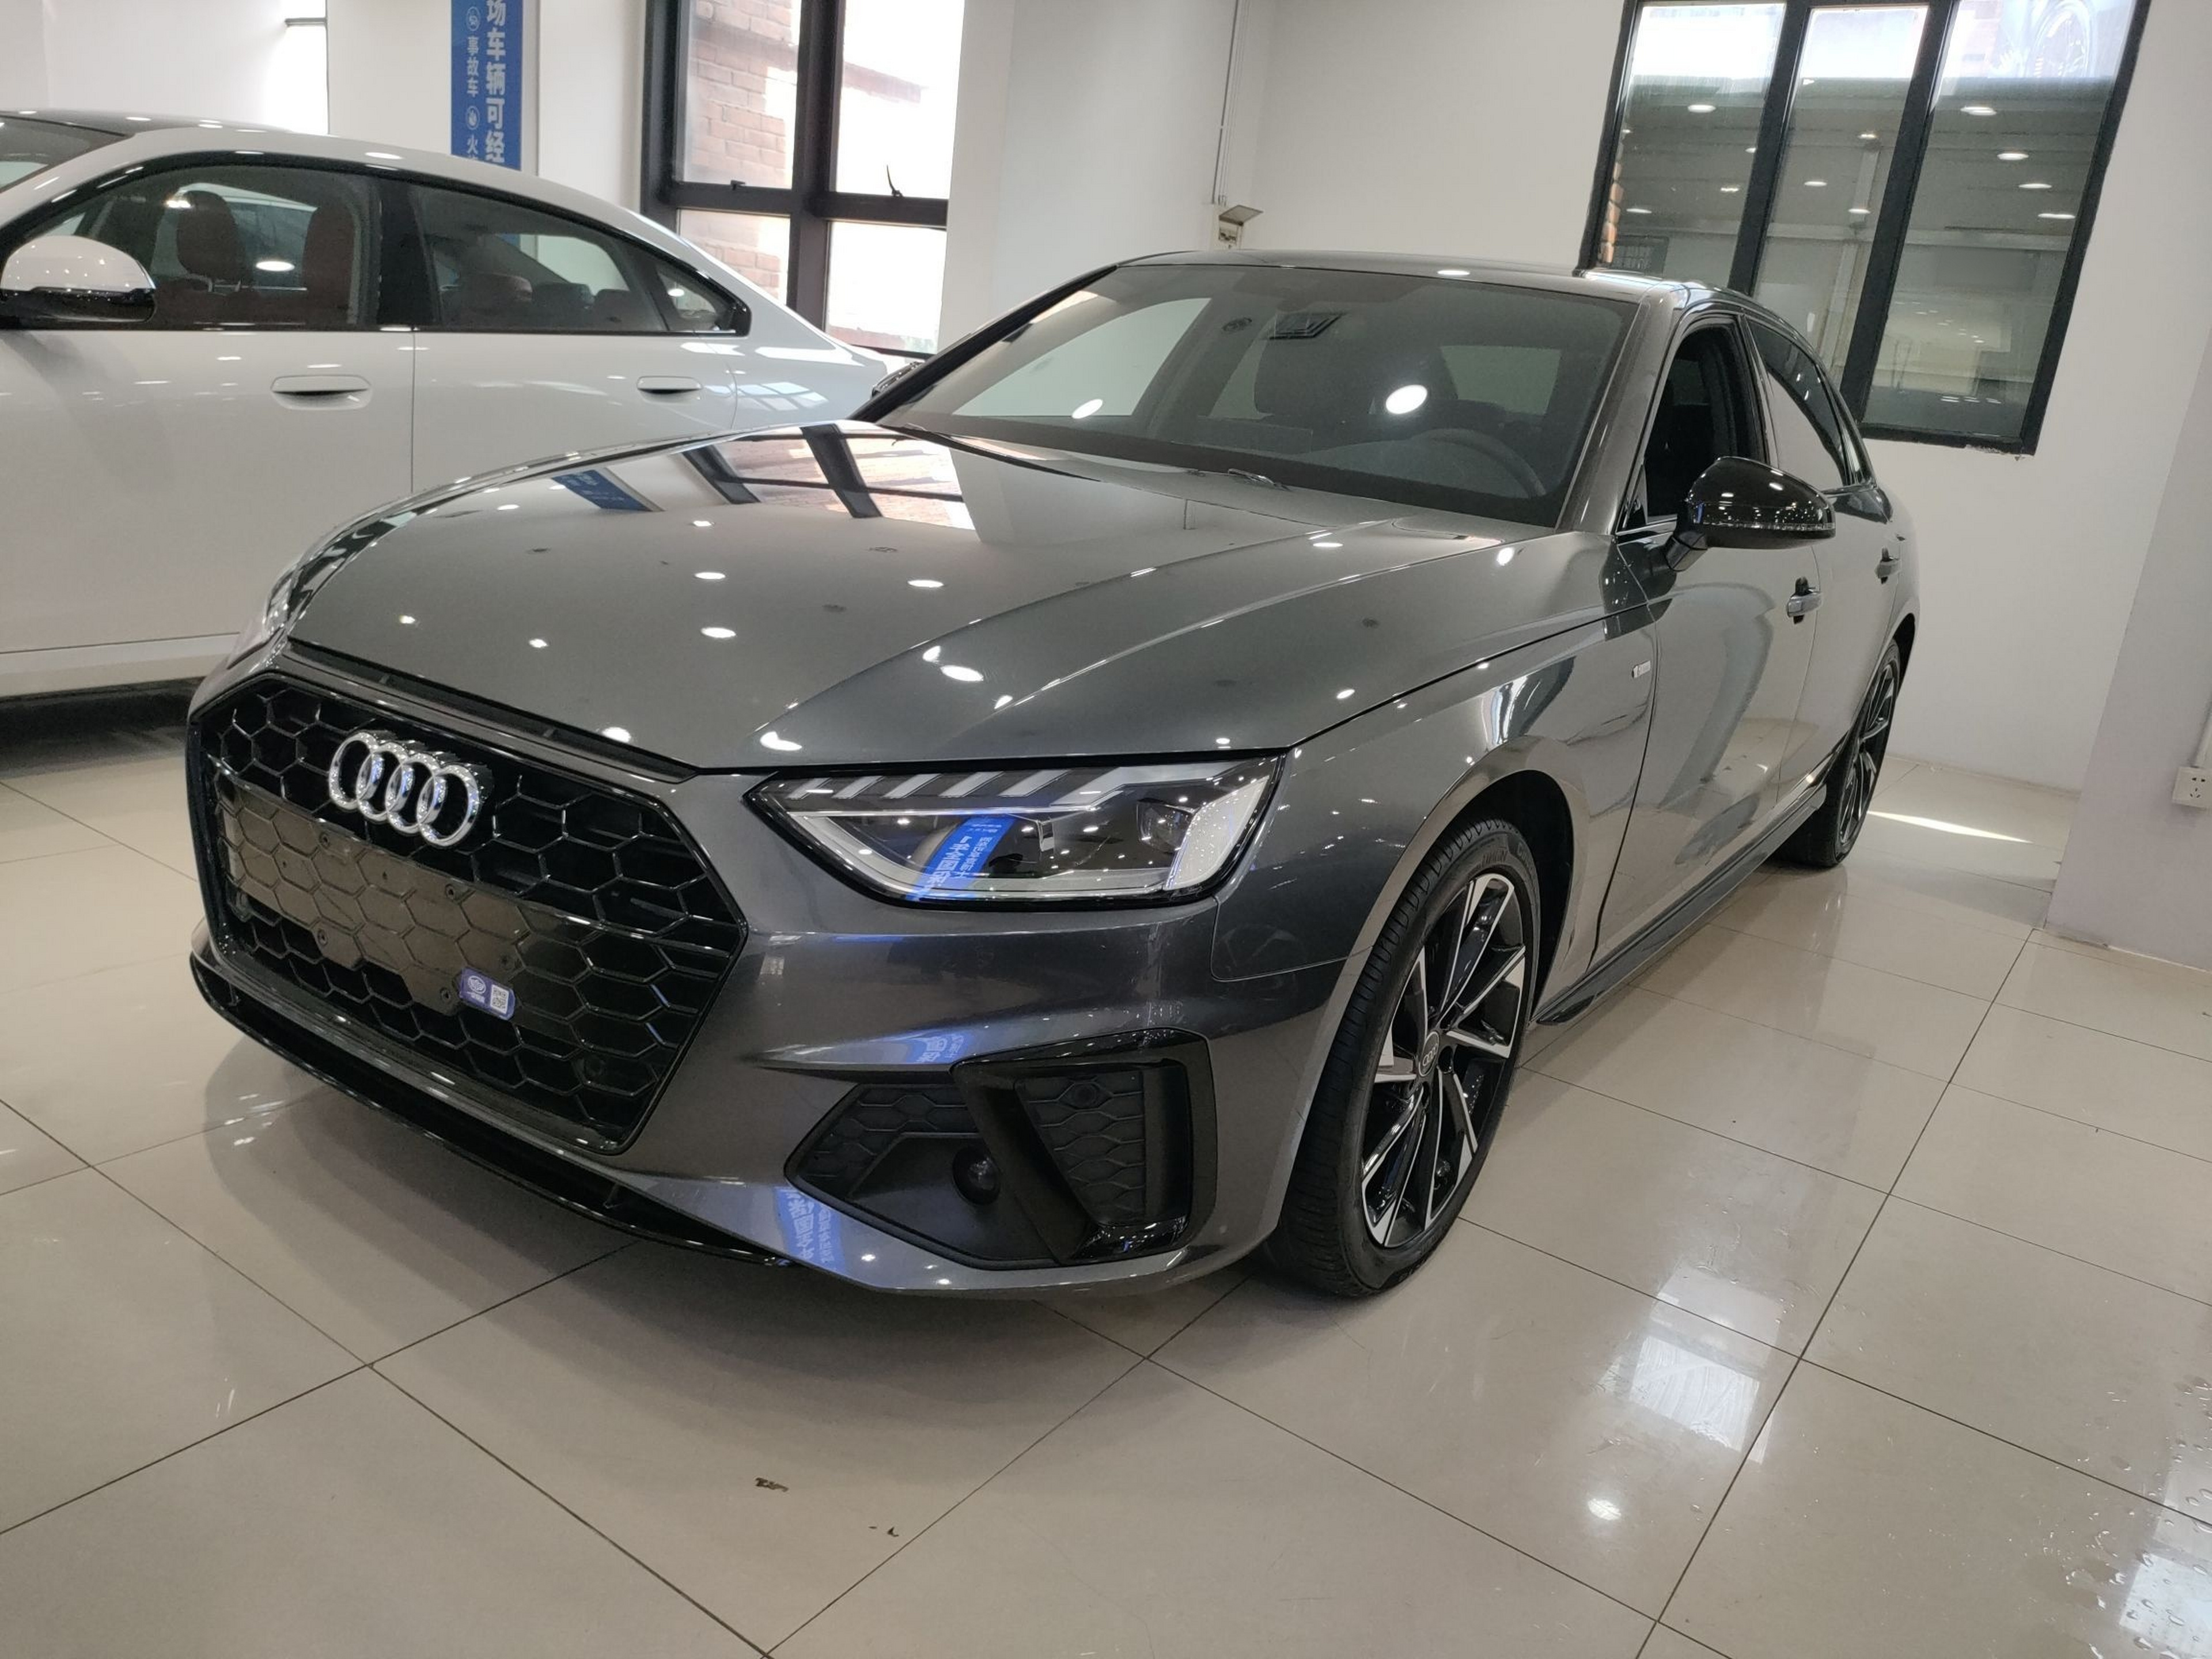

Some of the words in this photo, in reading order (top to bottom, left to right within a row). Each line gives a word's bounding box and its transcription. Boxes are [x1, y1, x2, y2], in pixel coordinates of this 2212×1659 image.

[467, 36, 479, 97] 事故车
[467, 134, 479, 160] 火
